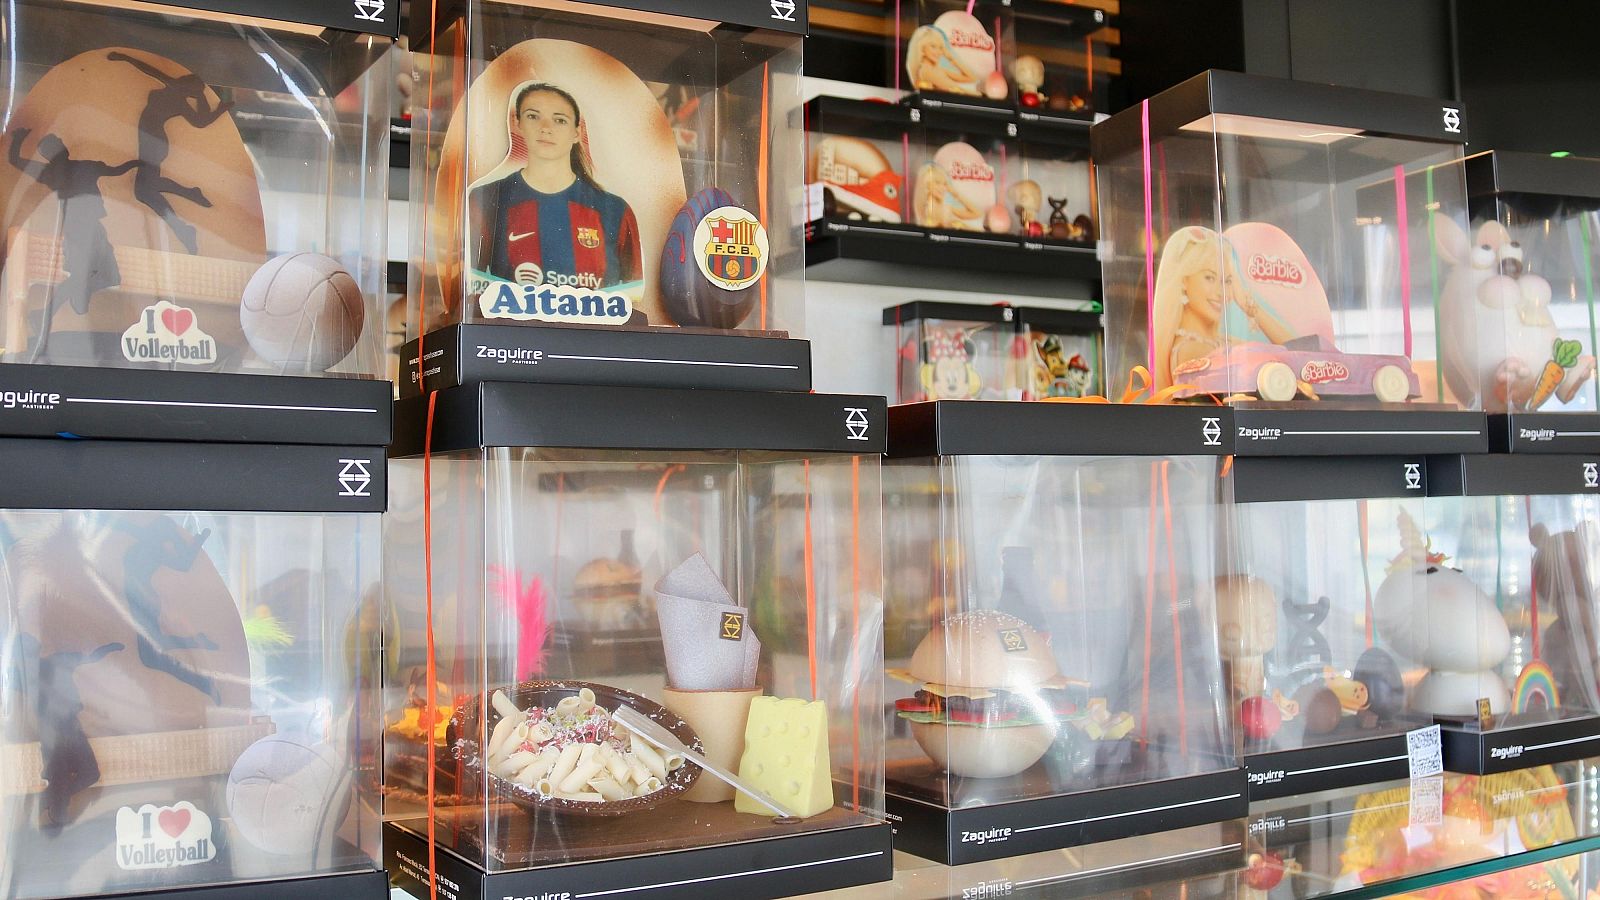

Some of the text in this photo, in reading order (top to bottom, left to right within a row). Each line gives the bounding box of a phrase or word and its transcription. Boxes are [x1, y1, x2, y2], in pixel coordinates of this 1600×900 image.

[714, 244, 754, 256] F.C.B.
[1250, 255, 1302, 284] Barbie
[546, 270, 602, 289] Spotify
[489, 283, 628, 318] Aitana
[145, 309, 156, 334] I
[125, 337, 212, 362] Volleyball
[476, 345, 543, 363] Zaguirre
[1305, 362, 1349, 384] Barbie
[1238, 426, 1281, 440] Zaguirre
[1520, 428, 1555, 441] Zaguirre
[1491, 744, 1524, 760] Zaguirre
[961, 826, 1012, 844] Zaguirre
[120, 838, 209, 868] Volleyball
